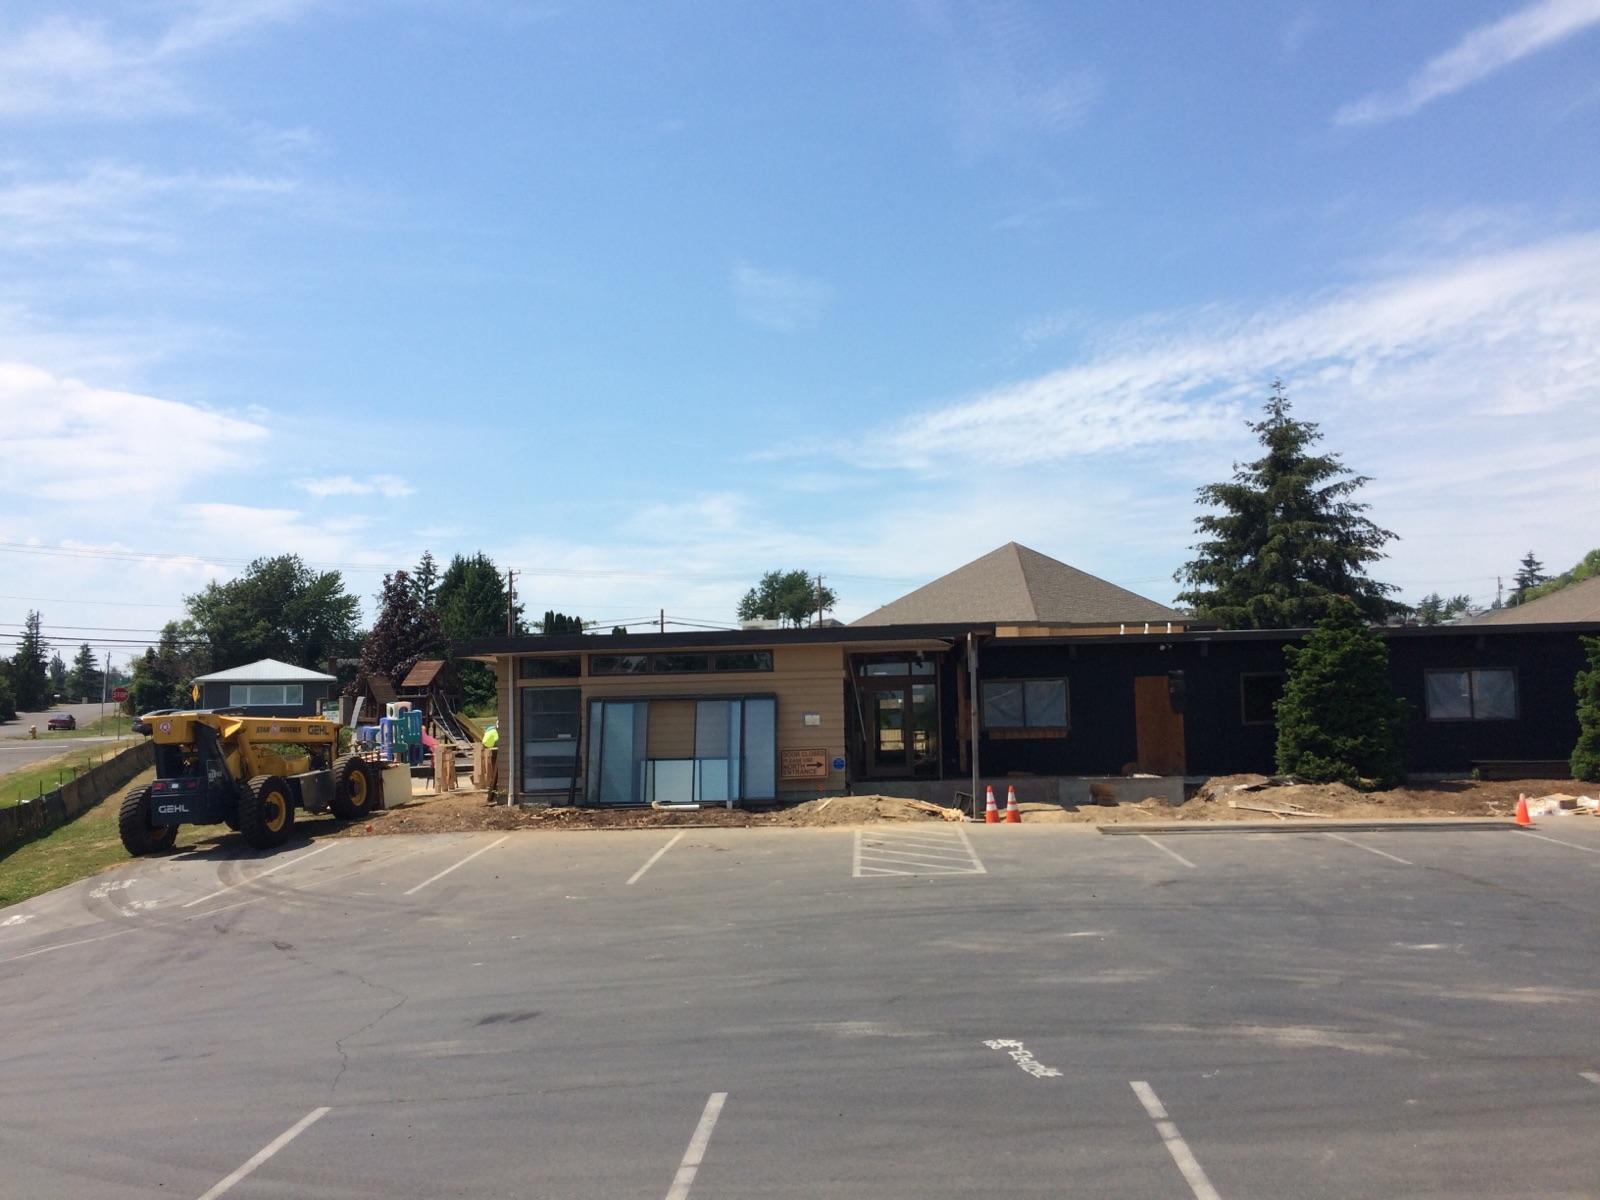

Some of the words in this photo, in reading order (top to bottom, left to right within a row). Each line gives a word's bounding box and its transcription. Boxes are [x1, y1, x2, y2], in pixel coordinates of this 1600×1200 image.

[113, 691, 128, 699] STOP
[308, 724, 329, 735] GEHL
[784, 768, 815, 776] ENTRANCE
[158, 803, 189, 814] GEHL
